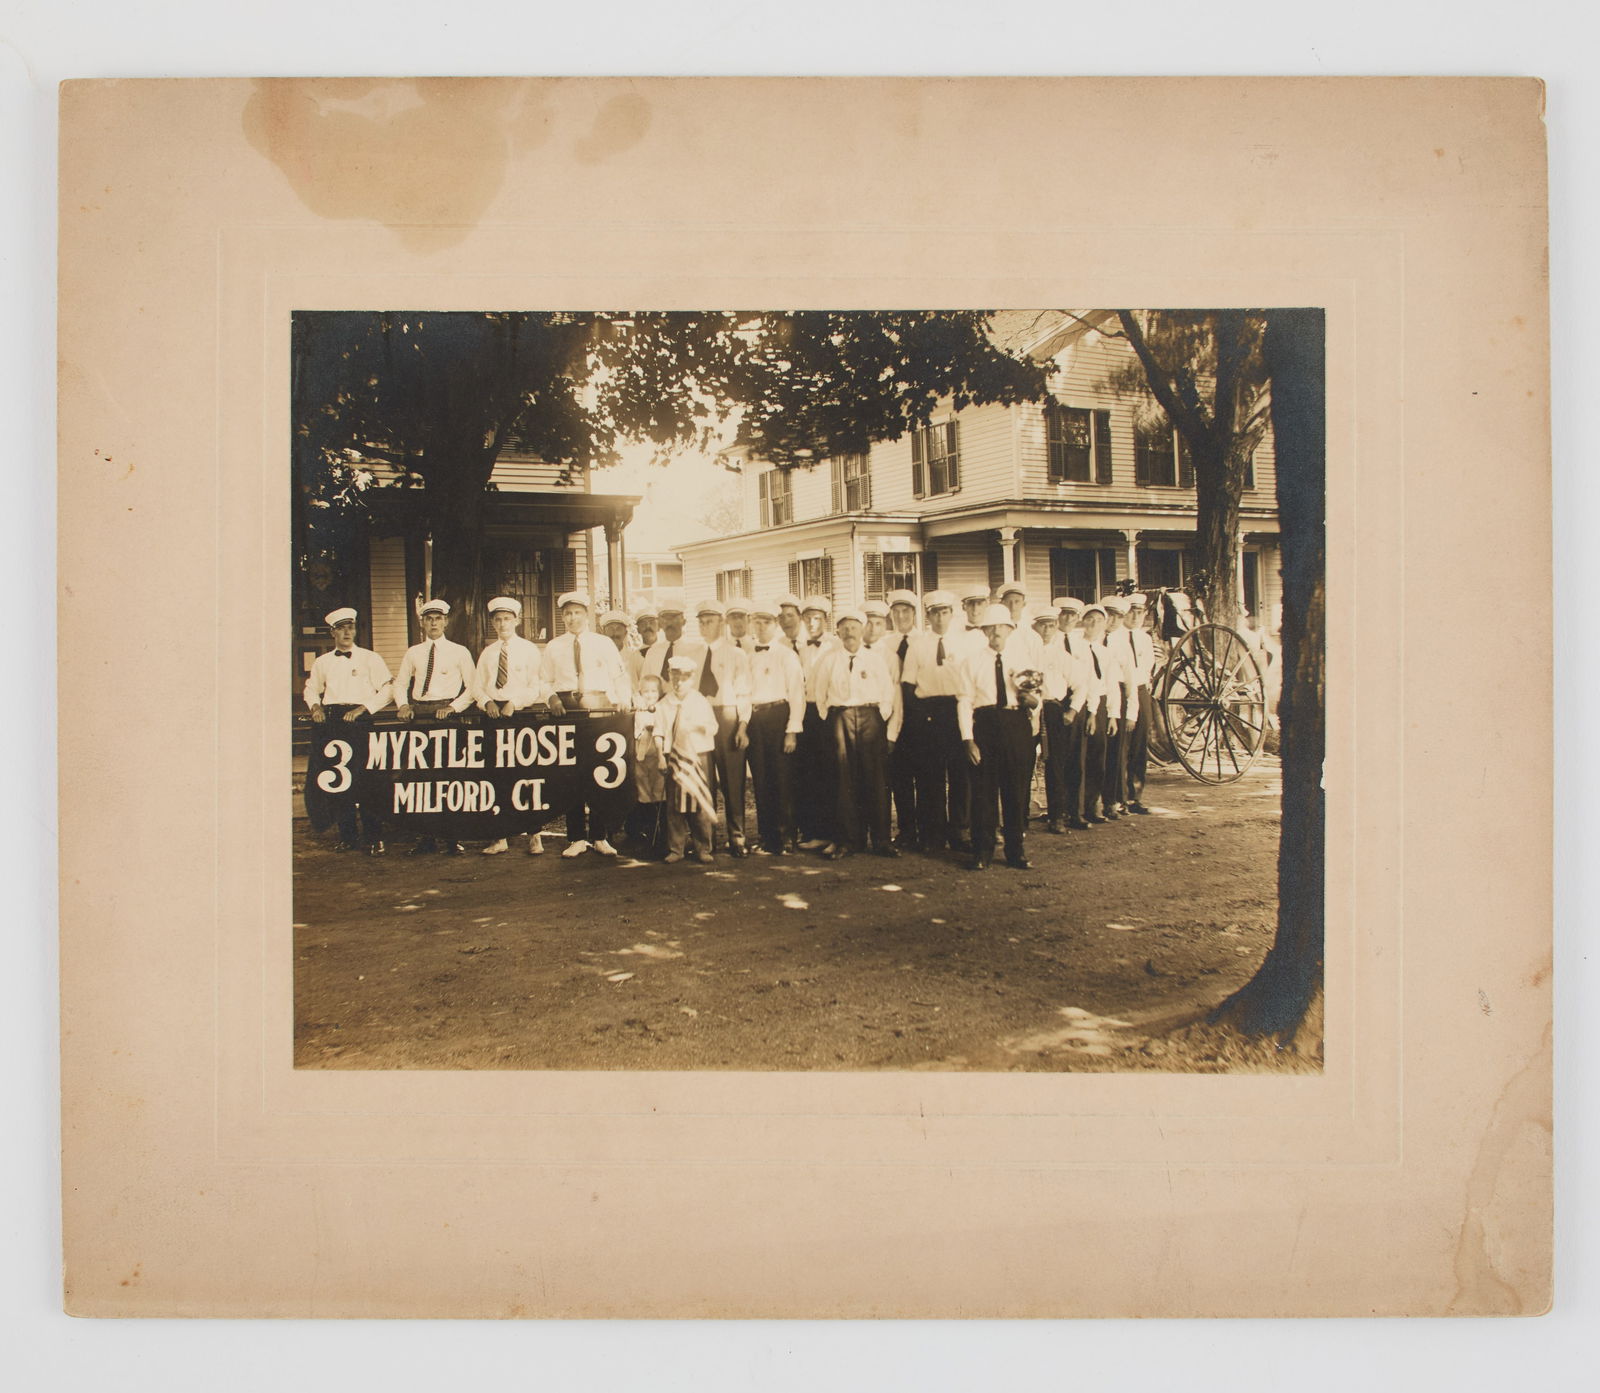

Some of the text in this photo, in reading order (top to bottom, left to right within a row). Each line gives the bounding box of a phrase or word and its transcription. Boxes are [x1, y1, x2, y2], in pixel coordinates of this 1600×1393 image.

[317, 739, 353, 794] 3
[366, 724, 577, 771] MYRTLE HOSE
[593, 731, 628, 790] 3
[393, 778, 550, 816] MILFORD, CT.
